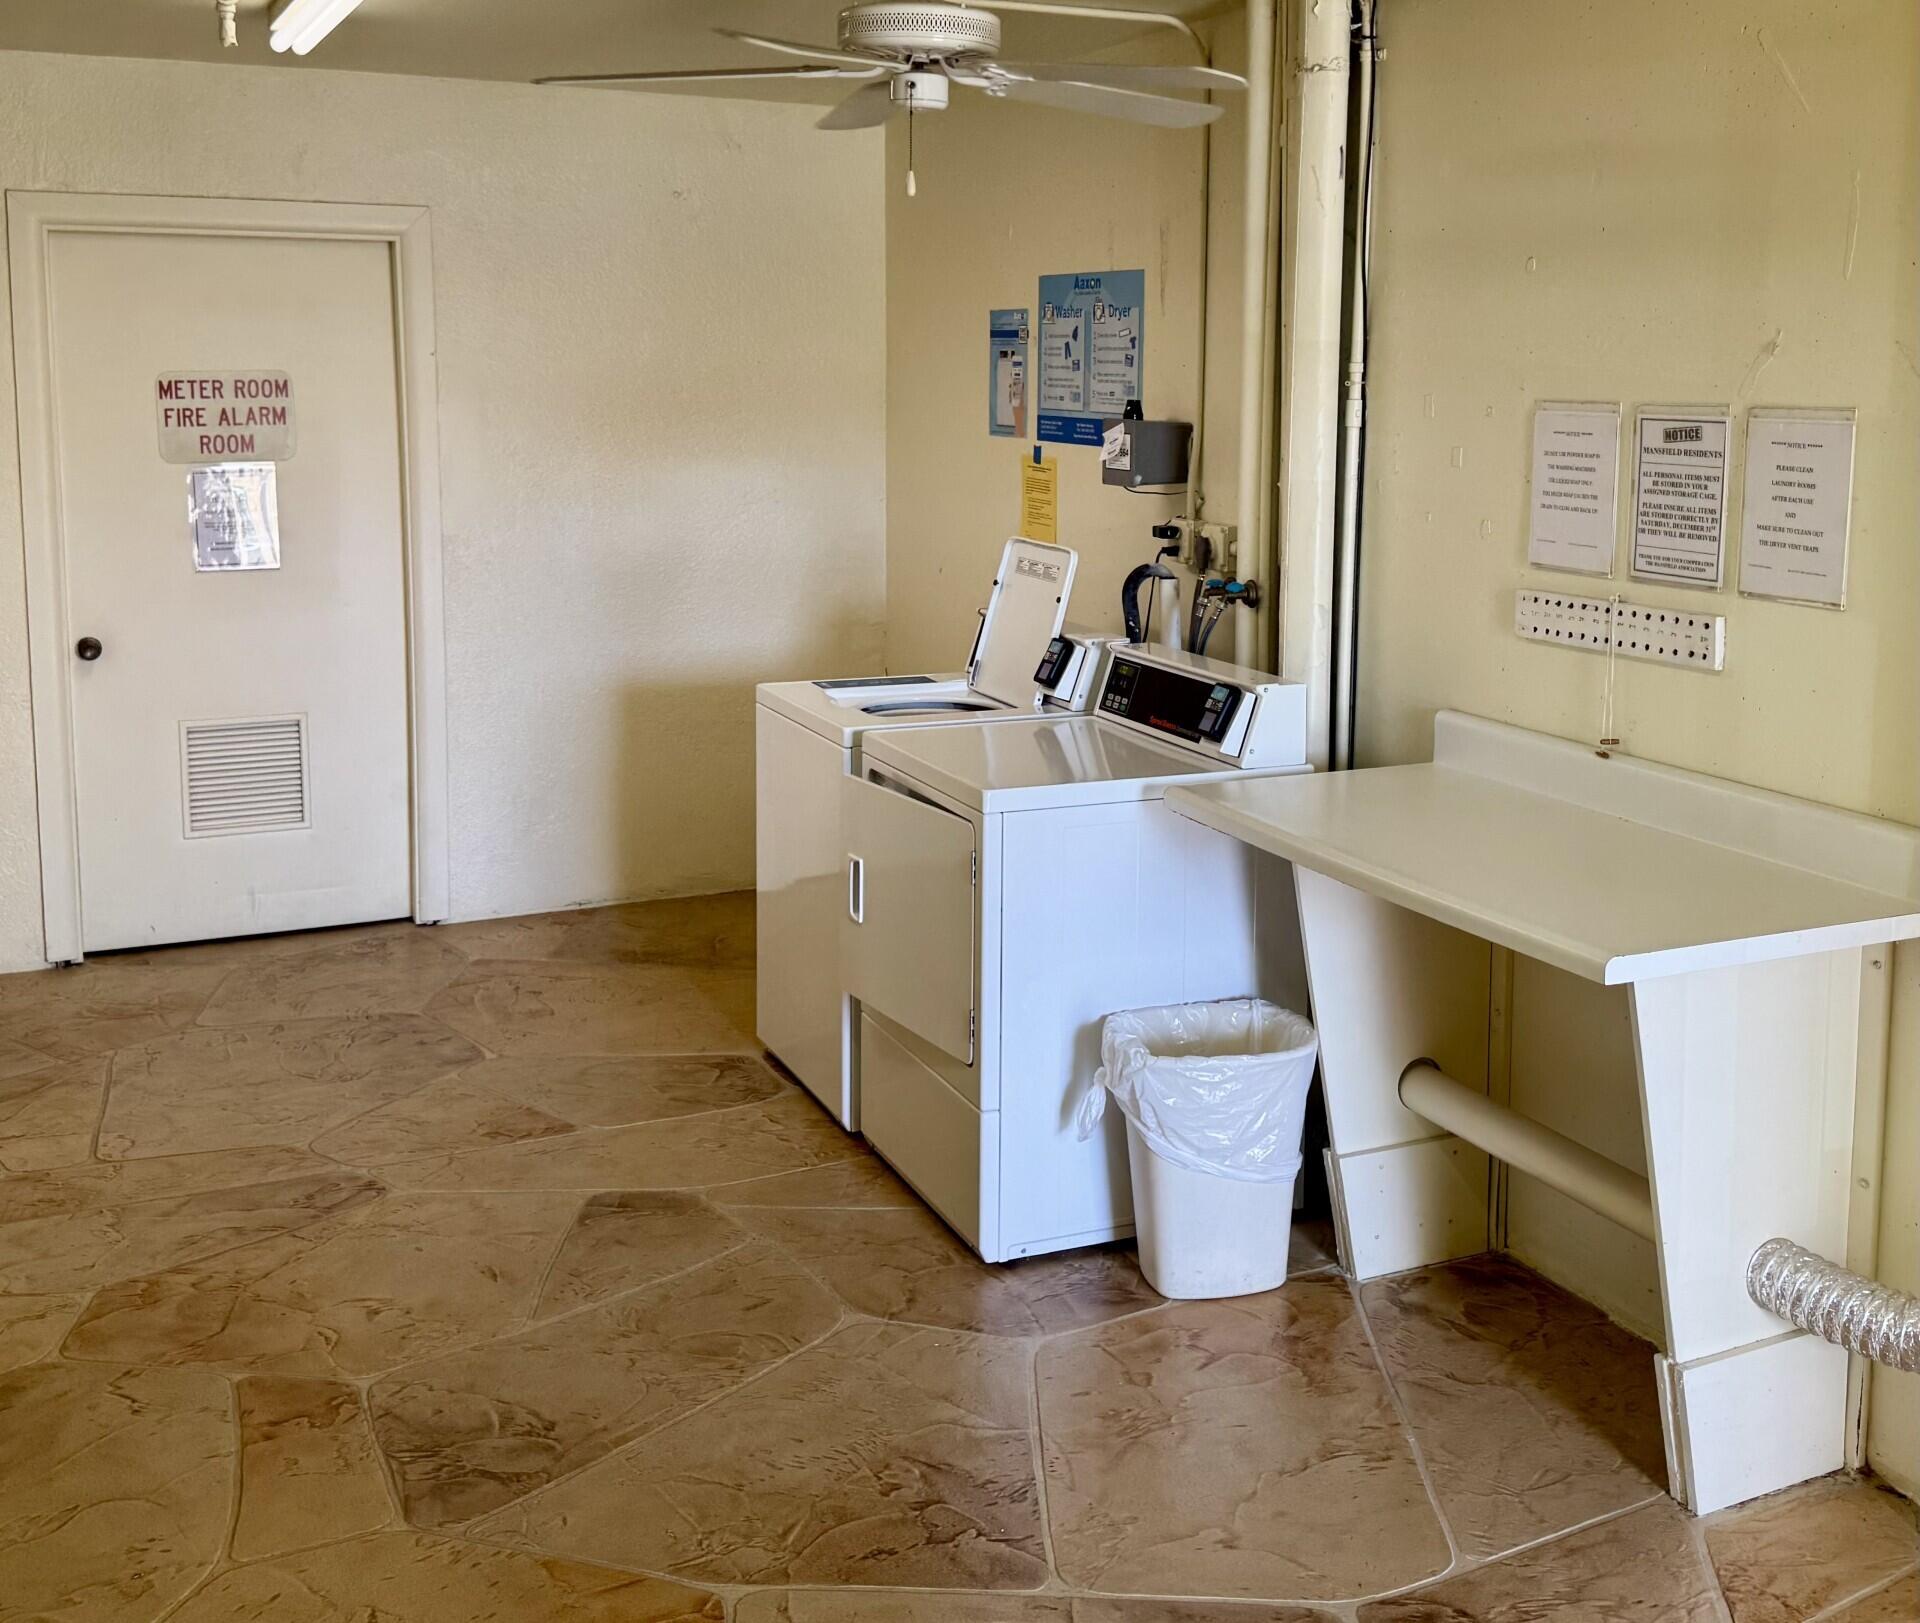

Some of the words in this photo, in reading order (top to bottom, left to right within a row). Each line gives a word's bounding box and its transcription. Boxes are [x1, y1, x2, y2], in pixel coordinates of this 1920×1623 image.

[1074, 276, 1102, 290] Aaxon
[1055, 304, 1082, 318] Washer
[1108, 304, 1131, 321] Dryer
[158, 379, 224, 400] METER
[234, 378, 289, 399] ROOM
[164, 407, 208, 428] FIRE
[218, 406, 288, 426] ALARM
[1664, 428, 1701, 441] NOTICE
[200, 434, 255, 454] ROOM
[1642, 446, 1682, 456] MANSFIELD
[1684, 448, 1722, 458] RESIDENTS
[1654, 472, 1682, 480] PERSONAL
[1671, 490, 1698, 498] STORAGE
[1642, 502, 1662, 510] PLEASE
[1664, 504, 1684, 512] INSURE
[1698, 507, 1717, 515] ITEMS
[1674, 514, 1709, 523] CORRECTLY
[1672, 523, 1704, 532] DECEMBER
[1757, 523, 1771, 532] MAKE
[1772, 525, 1785, 534] SURE
[1794, 528, 1812, 536] CLEAN
[1769, 541, 1787, 549] DRYER
[1788, 543, 1802, 551] VENT
[1802, 544, 1819, 553] TRAPS
